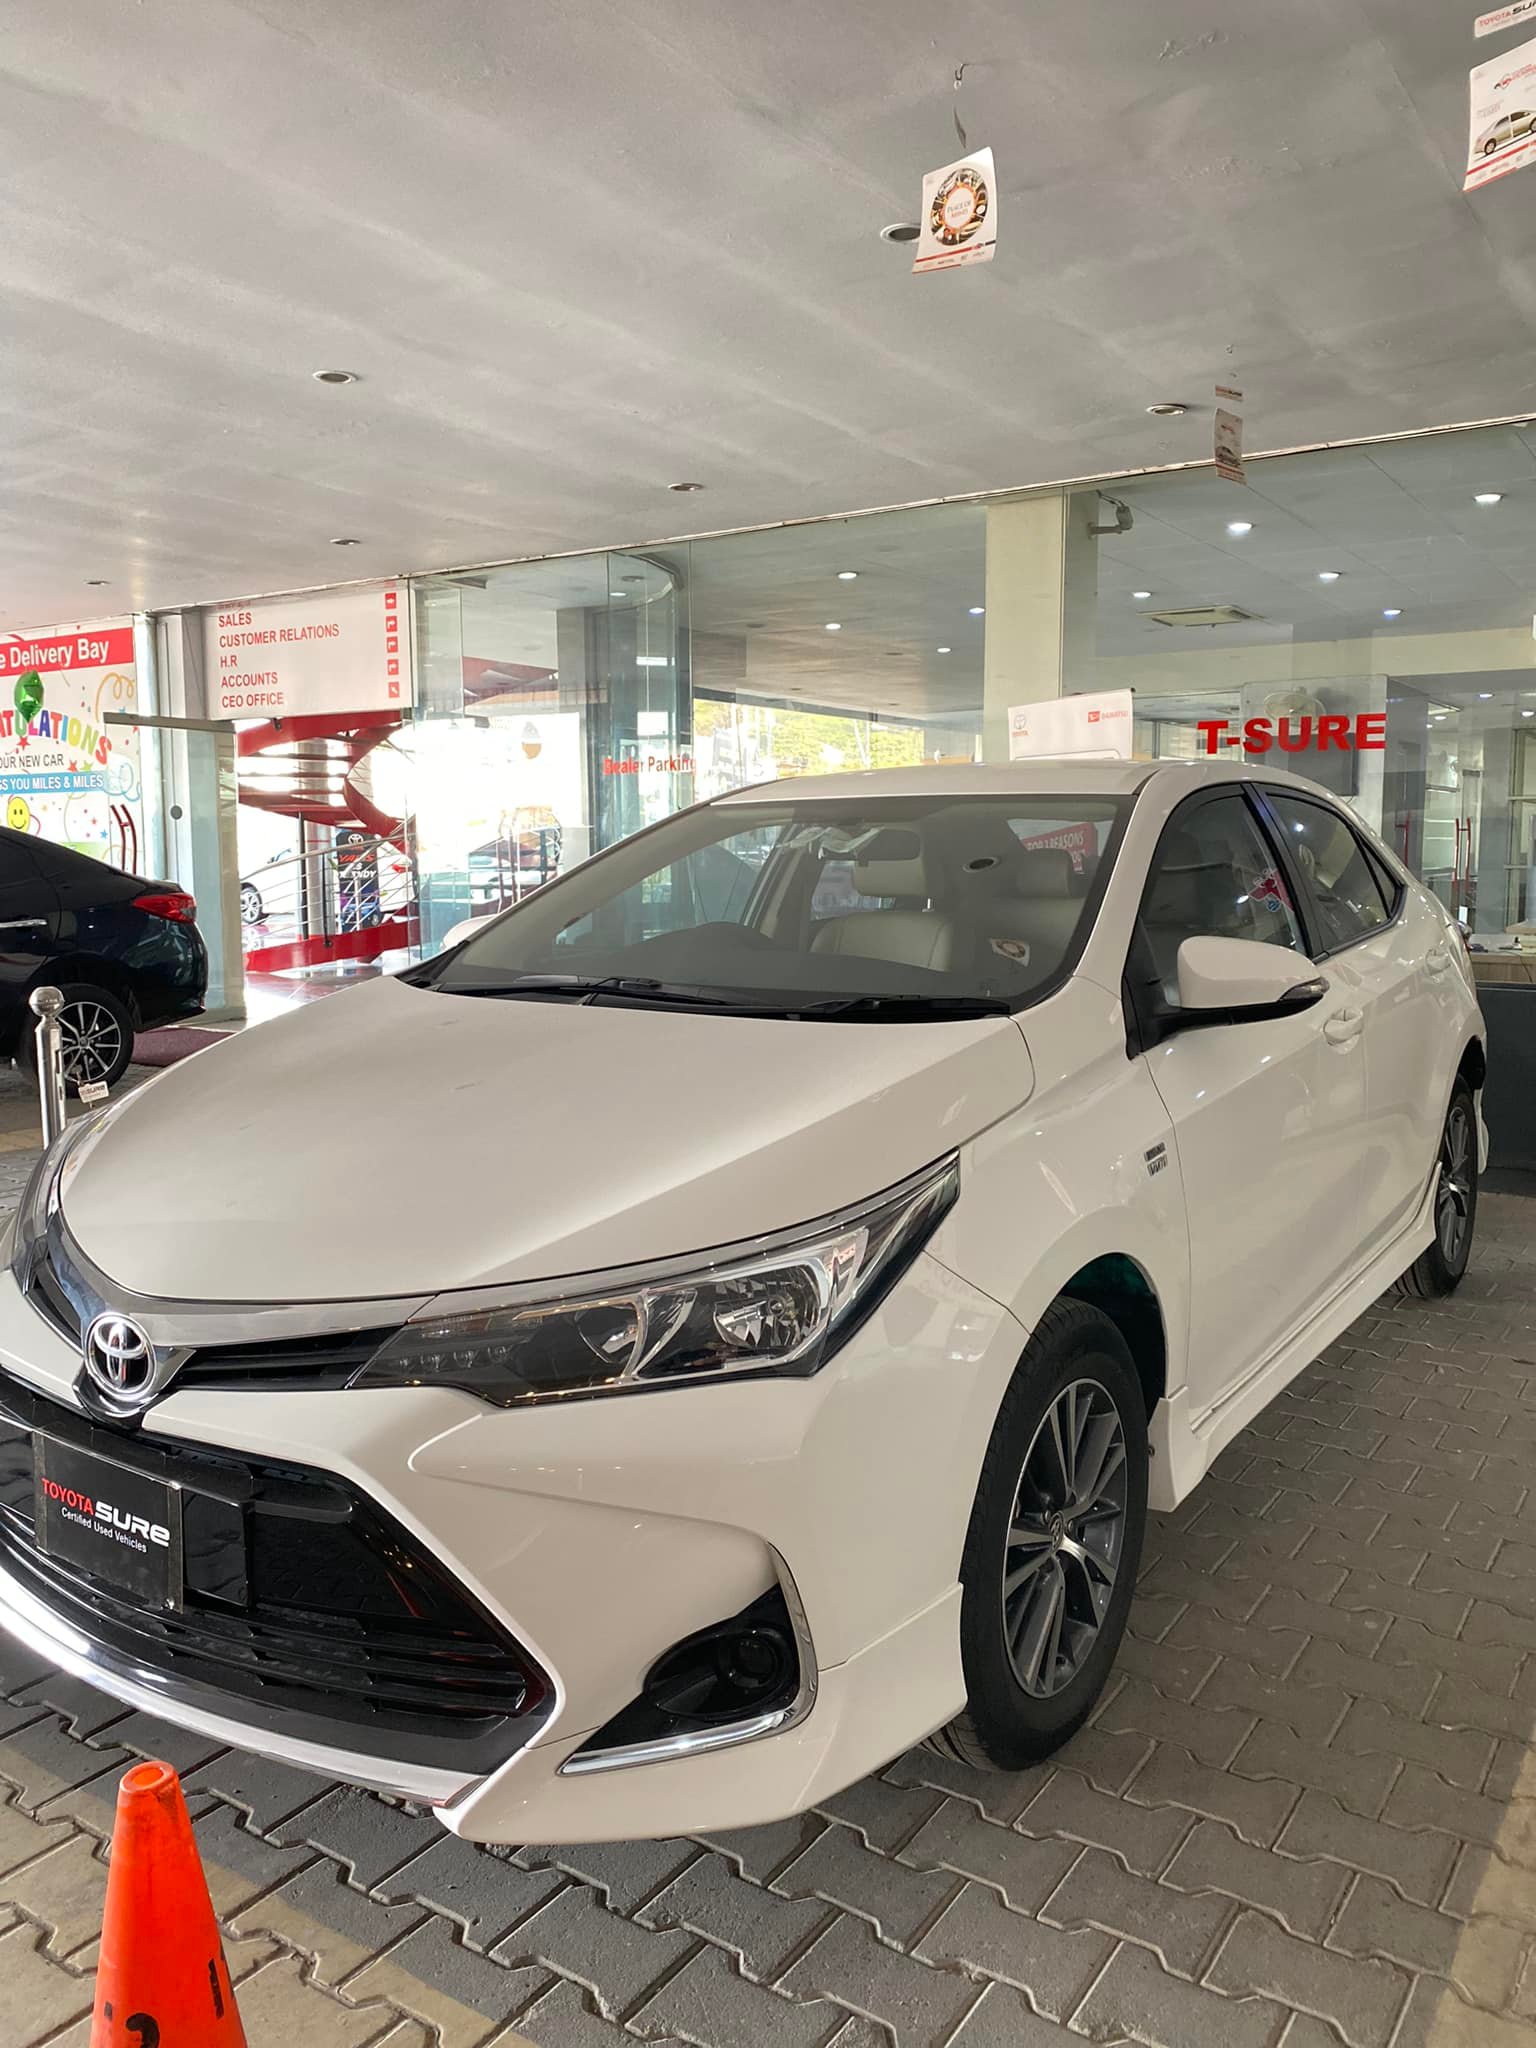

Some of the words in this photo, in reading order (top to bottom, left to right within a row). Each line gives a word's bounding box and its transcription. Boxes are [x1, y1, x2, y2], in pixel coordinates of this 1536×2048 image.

[218, 612, 252, 628] SALES
[219, 630, 277, 648] CUSTOMER
[280, 623, 340, 642] RELATIONS
[10, 644, 73, 668] Delivery
[77, 638, 109, 664] Bay
[220, 655, 238, 668] H.R
[221, 671, 278, 688] ACCOUNTS
[222, 694, 244, 708] CEO
[246, 692, 284, 707] OFFICE
[1197, 712, 1386, 754] T-SURE
[19, 754, 41, 768] NEW
[43, 753, 64, 767] CAR
[648, 754, 696, 774] Parking
[10, 778, 29, 790] YOU
[32, 776, 60, 790] MILES
[63, 775, 71, 788] &
[72, 774, 104, 788] MILES
[41, 1477, 94, 1516] TOYOTA
[61, 1507, 92, 1529] Certified
[93, 1522, 113, 1539] Used
[114, 1530, 147, 1553] Vehicles
